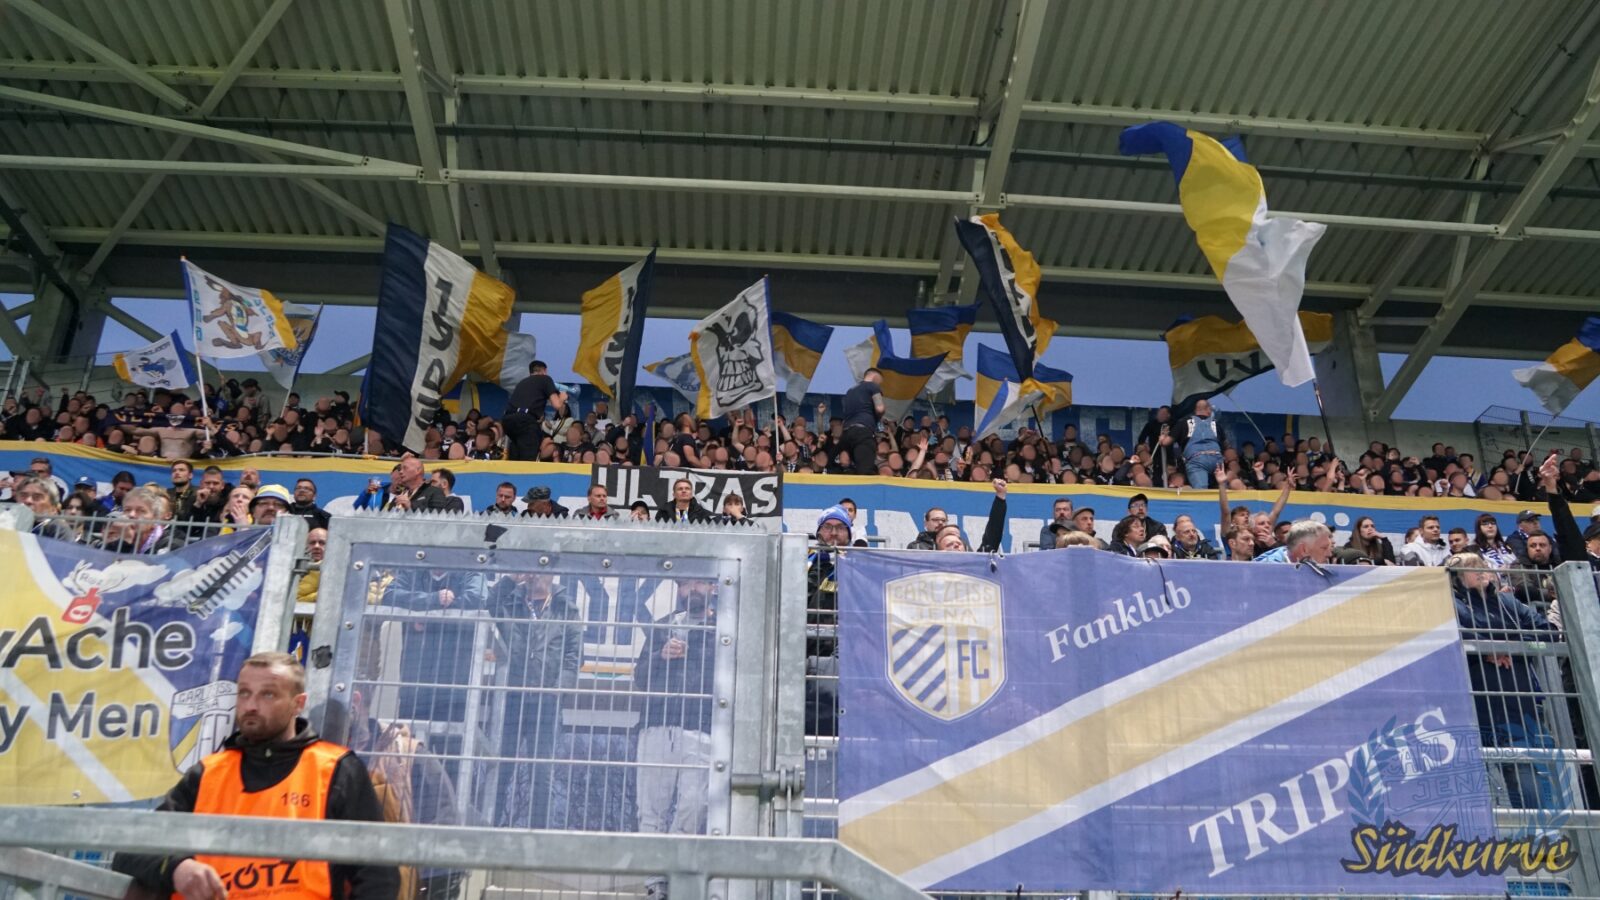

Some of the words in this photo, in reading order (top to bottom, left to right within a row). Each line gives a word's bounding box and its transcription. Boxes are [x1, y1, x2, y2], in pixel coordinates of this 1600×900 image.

[598, 467, 778, 515] ULTRAS
[1045, 580, 1191, 663] Fanklub
[957, 639, 990, 679] FC
[47, 692, 160, 739] Men
[281, 792, 310, 807] 186
[1189, 707, 1456, 878] TRIPTIS
